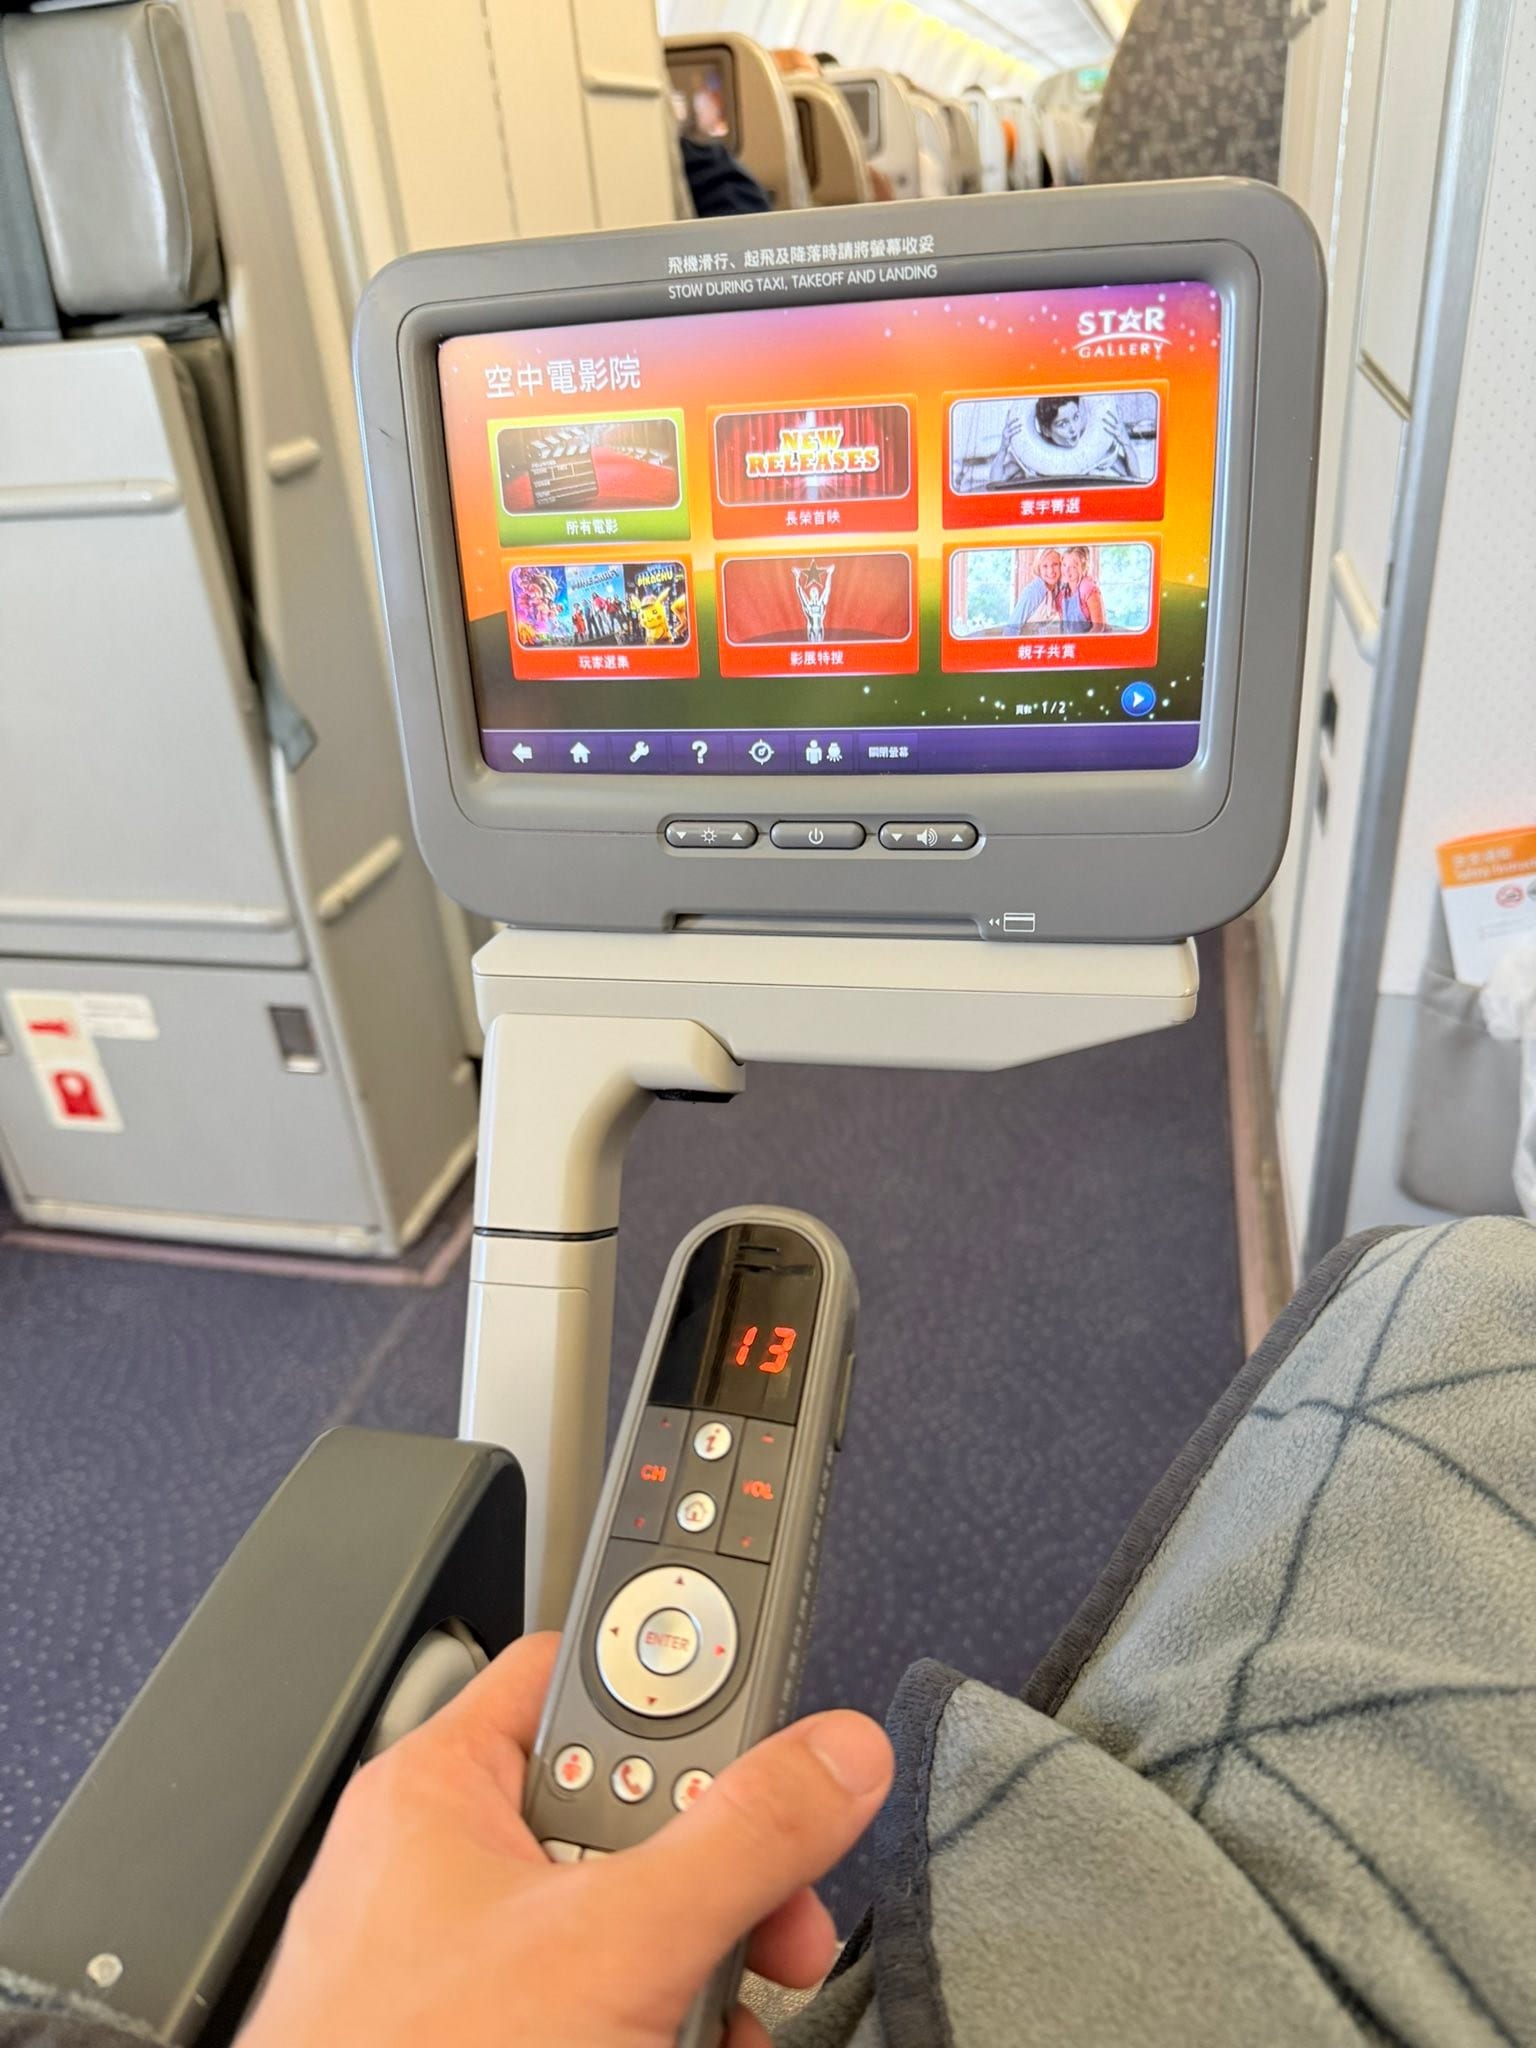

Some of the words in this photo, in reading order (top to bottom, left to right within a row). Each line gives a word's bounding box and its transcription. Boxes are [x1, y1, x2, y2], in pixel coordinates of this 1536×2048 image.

[667, 234, 935, 275] 飛機滑行、起飛及降落時請將螢幕收妥
[668, 283, 703, 300] STOW
[705, 278, 754, 297] DURING
[756, 276, 788, 292] TAXI,
[791, 270, 844, 289] TAKEOFF
[847, 268, 876, 285] AND
[879, 263, 938, 282] LANDING
[1078, 306, 1166, 336] STAR
[1078, 342, 1163, 360] GALLERY
[484, 353, 641, 399] 空中電影院
[781, 426, 843, 450] NEW
[746, 448, 879, 478] RELEASES
[565, 518, 619, 536] 所有電影
[785, 509, 841, 527] 長榮首映
[636, 566, 674, 588] PIKACHU
[1017, 643, 1076, 660] 親子共賞
[578, 655, 630, 670] 玩家選集
[1041, 700, 1067, 715] 1/2
[735, 1326, 797, 1374] 13
[640, 1464, 668, 1482] CH
[742, 1480, 774, 1500] VOL
[645, 1631, 690, 1650] ENTER
